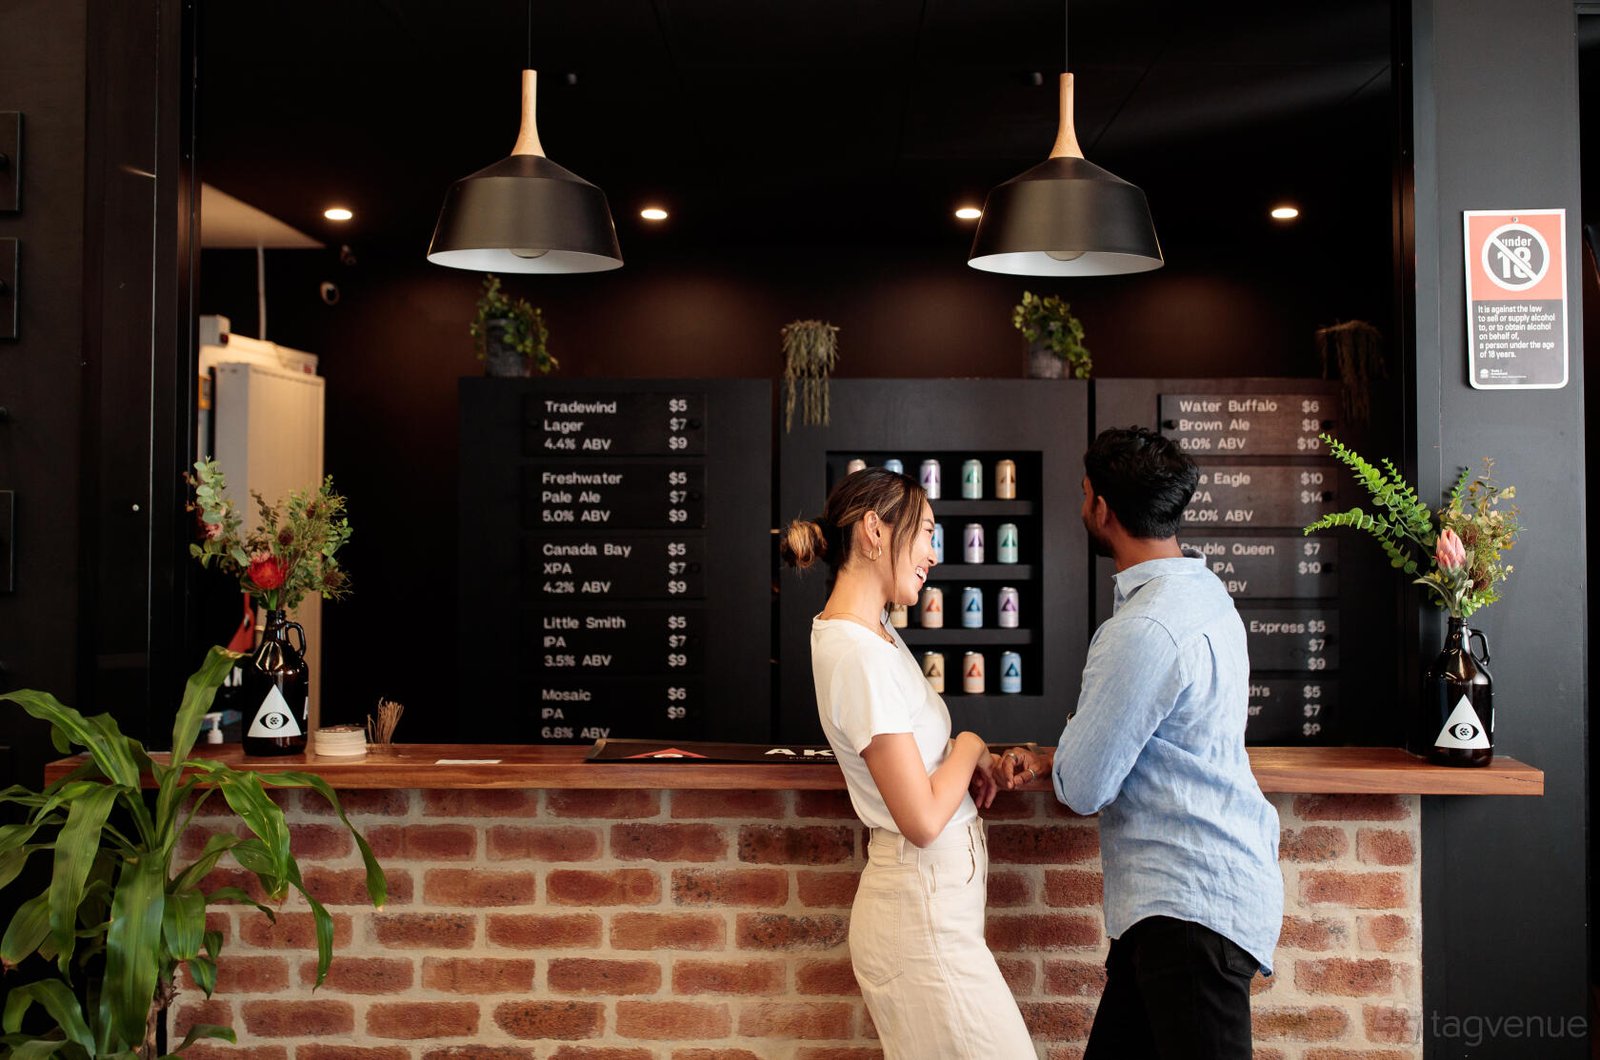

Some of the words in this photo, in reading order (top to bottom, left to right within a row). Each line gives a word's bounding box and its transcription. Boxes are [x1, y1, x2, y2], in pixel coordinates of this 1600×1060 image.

[1501, 236, 1532, 247] under
[1497, 247, 1532, 279] 18
[1478, 305, 1483, 313] It
[1484, 305, 1490, 313] is
[1491, 305, 1516, 314] against
[1487, 314, 1498, 322] sell
[1508, 314, 1530, 323] supply
[1531, 313, 1556, 321] alcohol
[1479, 324, 1488, 332] to,
[1505, 323, 1526, 331] obtain
[1527, 323, 1552, 331] alcohol
[1489, 332, 1510, 340] behalf
[1511, 332, 1519, 340] of,
[1485, 342, 1508, 351] person
[1510, 341, 1529, 349] under
[1530, 341, 1541, 349] the
[1542, 342, 1555, 350] age
[1488, 350, 1495, 358] 18
[1496, 351, 1516, 359] years.
[545, 401, 617, 414] Tradewind
[669, 399, 688, 413] $5
[1179, 401, 1222, 413] Water
[1228, 400, 1278, 413] Buffalo
[1301, 400, 1319, 414] $6
[544, 419, 584, 434] Lager
[669, 417, 687, 432] $7
[1179, 419, 1222, 431] Brown
[1229, 419, 1250, 431] Ale
[1302, 418, 1320, 432] $8
[544, 438, 576, 450] 4.4%
[582, 438, 612, 450] ABV
[668, 436, 688, 450] $9
[1217, 437, 1246, 450] ABV
[1297, 437, 1320, 451] $10
[542, 472, 623, 485] Freshwater
[668, 471, 687, 485] $5
[1214, 472, 1251, 487] Eagle
[1300, 472, 1323, 486] $10
[542, 491, 572, 503] Pale
[579, 491, 601, 503] Ale
[669, 490, 687, 504] $7
[1300, 490, 1323, 504] $14
[542, 510, 575, 522] 5.0%
[581, 510, 611, 522] ABV
[668, 509, 688, 523] $9
[1183, 509, 1219, 522] 12.0%
[1225, 509, 1253, 522] ABV
[542, 543, 597, 556] Canada
[604, 544, 632, 558] Bay
[667, 542, 686, 556] $5
[1232, 543, 1275, 555] Queen
[1304, 542, 1321, 556] $7
[543, 563, 572, 574] XPA
[668, 561, 687, 576] $7
[1213, 562, 1235, 574] IPA
[1298, 561, 1321, 575] $10
[543, 582, 575, 593] 4.2%
[581, 581, 611, 593] ABV
[667, 580, 687, 594] $9
[543, 616, 580, 629] Little
[585, 616, 627, 629] Smith
[668, 615, 687, 630] $5
[1250, 620, 1305, 635] Express
[1308, 619, 1326, 634] $5
[543, 636, 567, 648] IPA
[668, 634, 687, 648] $7
[1308, 638, 1326, 652] $7
[544, 655, 576, 667] 3.5%
[582, 655, 612, 667] ABV
[667, 653, 688, 668] $9
[1307, 657, 1326, 671] $9
[542, 689, 592, 701] Mosaic
[667, 687, 687, 701] $6
[1303, 685, 1322, 699] $5
[541, 708, 565, 720] IPA
[667, 706, 687, 720] $9
[1303, 703, 1322, 718] $7
[541, 727, 574, 739] 6.8%
[580, 727, 611, 739] ABV
